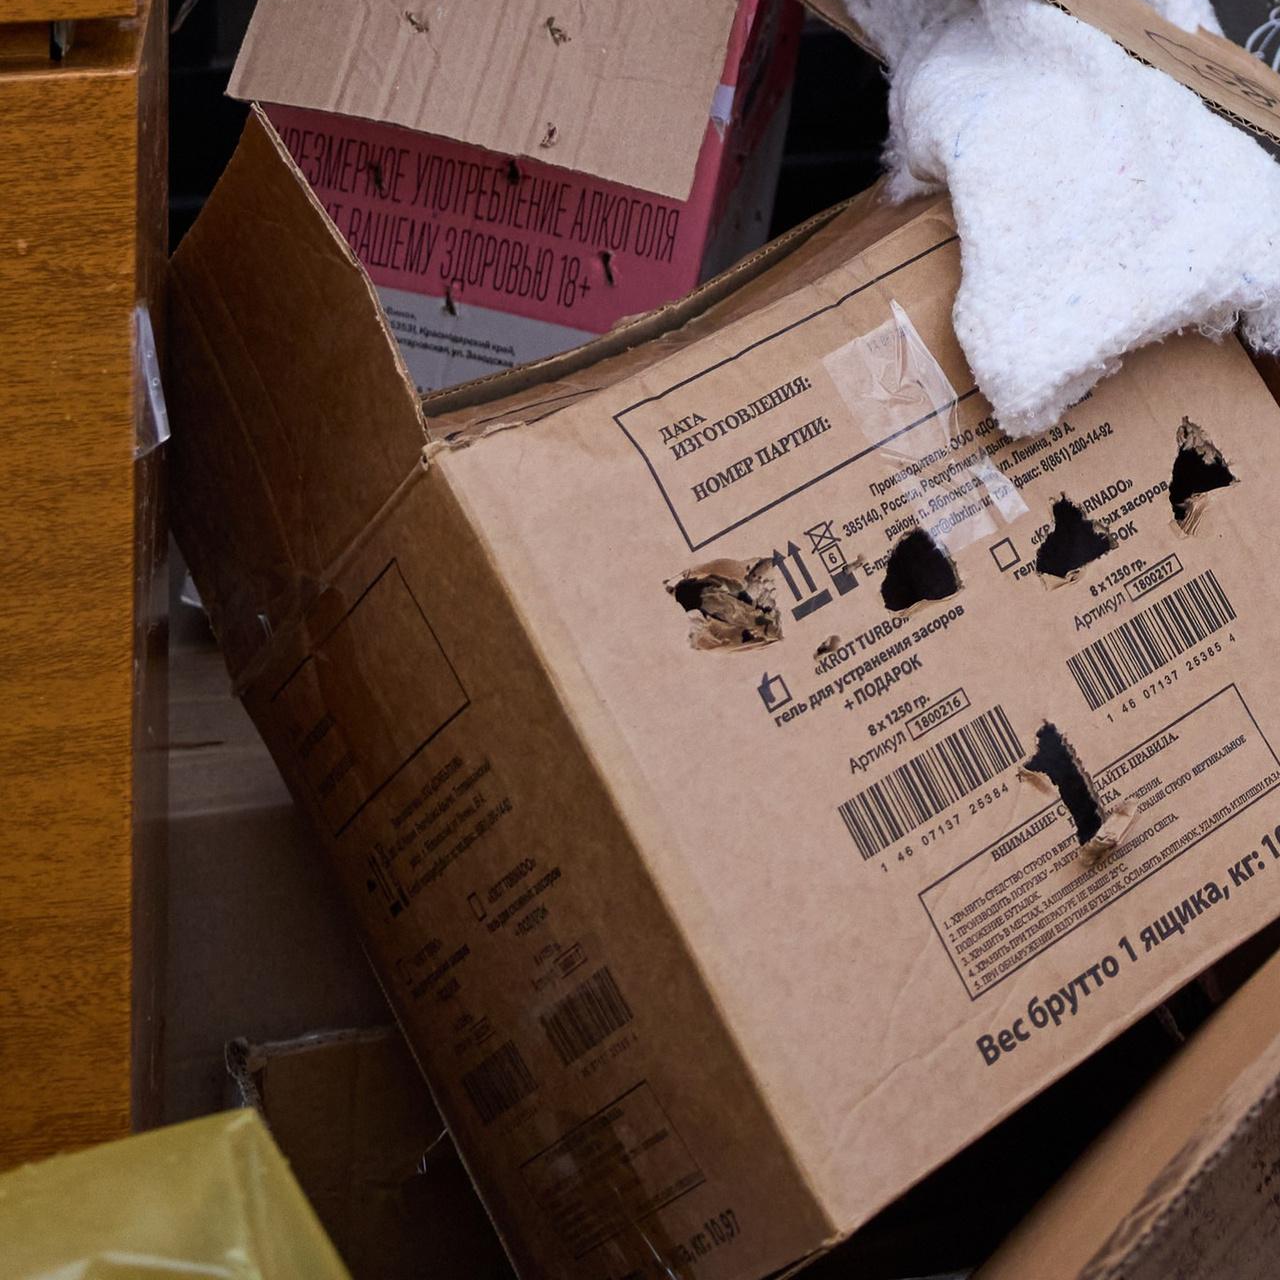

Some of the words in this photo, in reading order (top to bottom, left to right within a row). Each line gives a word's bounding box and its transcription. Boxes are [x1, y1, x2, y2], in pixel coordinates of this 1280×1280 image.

[410, 151, 572, 239] УПОТРЕБЛЕНИЕ
[570, 187, 681, 264] АЛКОГОЛЯ
[347, 206, 441, 276] ВАШЕМУ
[439, 226, 554, 302] ЗДОРОВЬЮ
[556, 256, 592, 308] 18+
[658, 412, 708, 445] ДАТА
[669, 375, 812, 461] ИЗГОТОВЛЕНИЯ:
[1039, 446, 1072, 472] 8(861)
[1068, 421, 1114, 456] 200-14-92
[690, 456, 754, 502] НОМЕР
[754, 416, 832, 467] ПАРТИИ:
[867, 441, 952, 499] Производитель:
[947, 428, 975, 451] ООО
[884, 514, 920, 541] район,
[1010, 437, 1053, 465] Ленина,
[1048, 426, 1064, 442] 39
[1119, 480, 1171, 516] засоров
[842, 508, 884, 538] 385140,
[879, 483, 923, 517] Россия,
[1074, 591, 1127, 632] Артикул
[1132, 560, 1177, 593] 1800217
[1089, 585, 1099, 597] 8
[1104, 564, 1131, 587] 1250
[774, 702, 808, 728] гель
[808, 683, 835, 710] для
[833, 636, 913, 694] устранения
[911, 605, 965, 643] засоров
[810, 639, 861, 678] «KROT
[853, 653, 923, 705] ПОДАРОК
[1122, 698, 1137, 713] 46
[1142, 669, 1178, 700] 07137
[1185, 641, 1222, 671] 25385
[1229, 633, 1236, 642] 4
[849, 730, 907, 775] Артикул
[912, 695, 964, 732] 1800216
[867, 724, 878, 737] 8
[884, 701, 914, 726] 1250
[897, 845, 914, 861] 46
[921, 813, 960, 846] 07137
[968, 782, 1009, 815] 25384
[990, 810, 1058, 862] ВНИМАНИЕ!
[1127, 732, 1180, 770] ПРАВИЛА.
[975, 1017, 1031, 1067] Вес
[1027, 955, 1120, 1029] брутто
[1118, 936, 1138, 963] 1
[1139, 881, 1230, 953] ящика,
[1227, 850, 1266, 888] кг:
